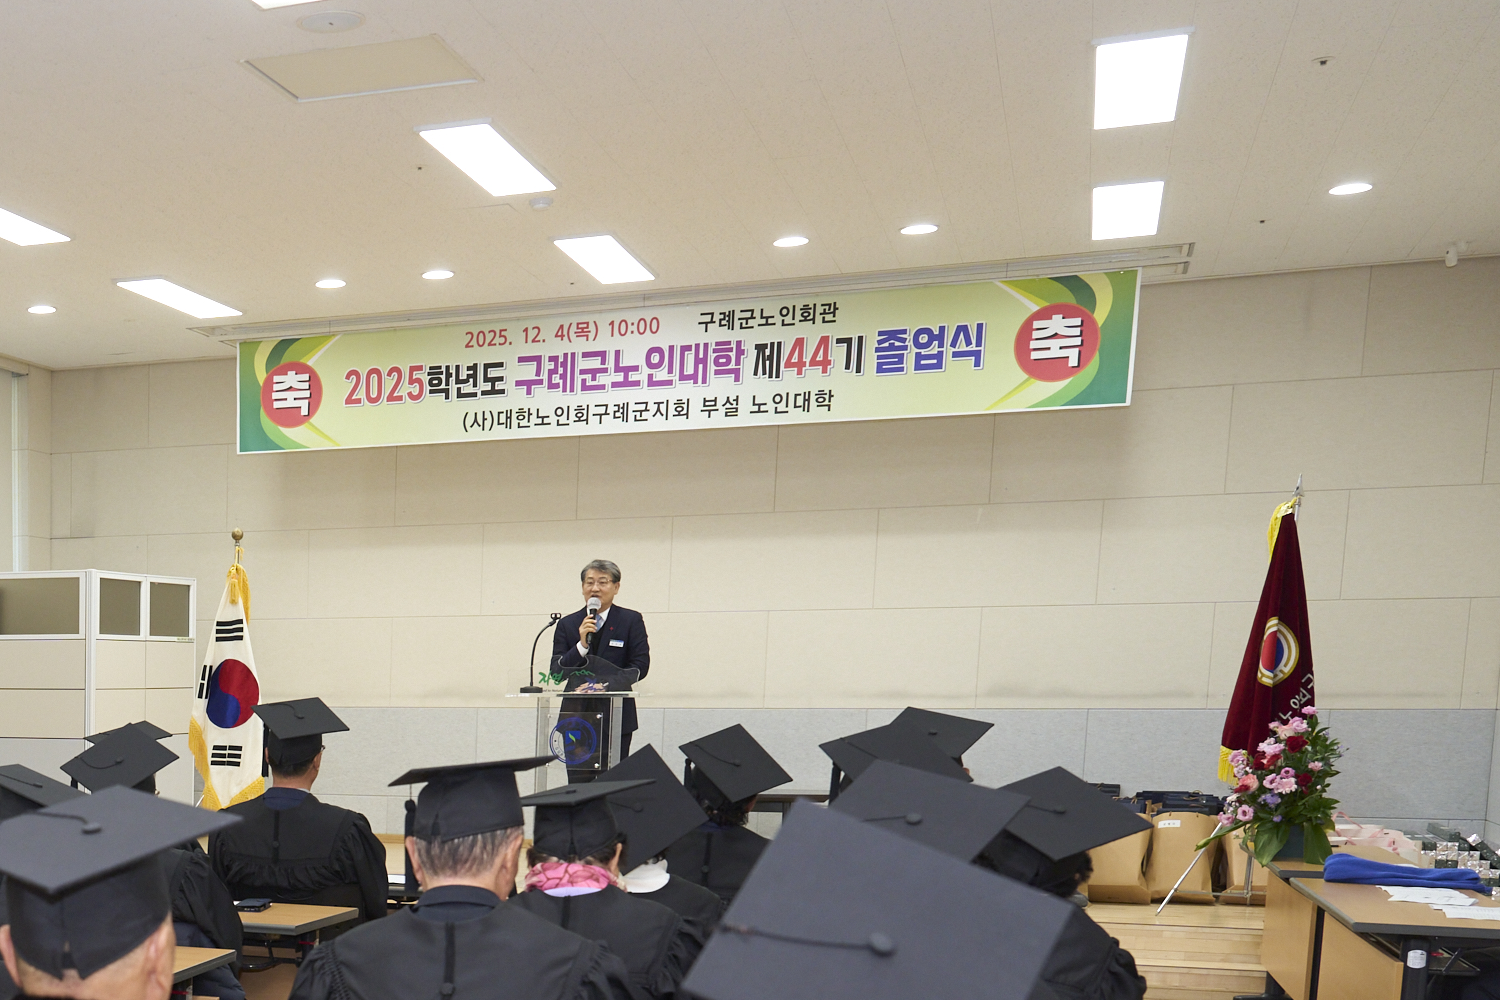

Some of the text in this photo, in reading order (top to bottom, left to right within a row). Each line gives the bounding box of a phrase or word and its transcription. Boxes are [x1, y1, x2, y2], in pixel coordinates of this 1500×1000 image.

[464, 301, 839, 349] 2025. 12. 4(목) 10:00 구례군노인회관
[1029, 314, 1083, 368] 축
[344, 321, 986, 406] 2025학년도 구례군노인대학 제44기 졸업식
[271, 370, 311, 416] 축
[701, 395, 740, 419] 부설
[749, 388, 835, 416] 노인대학
